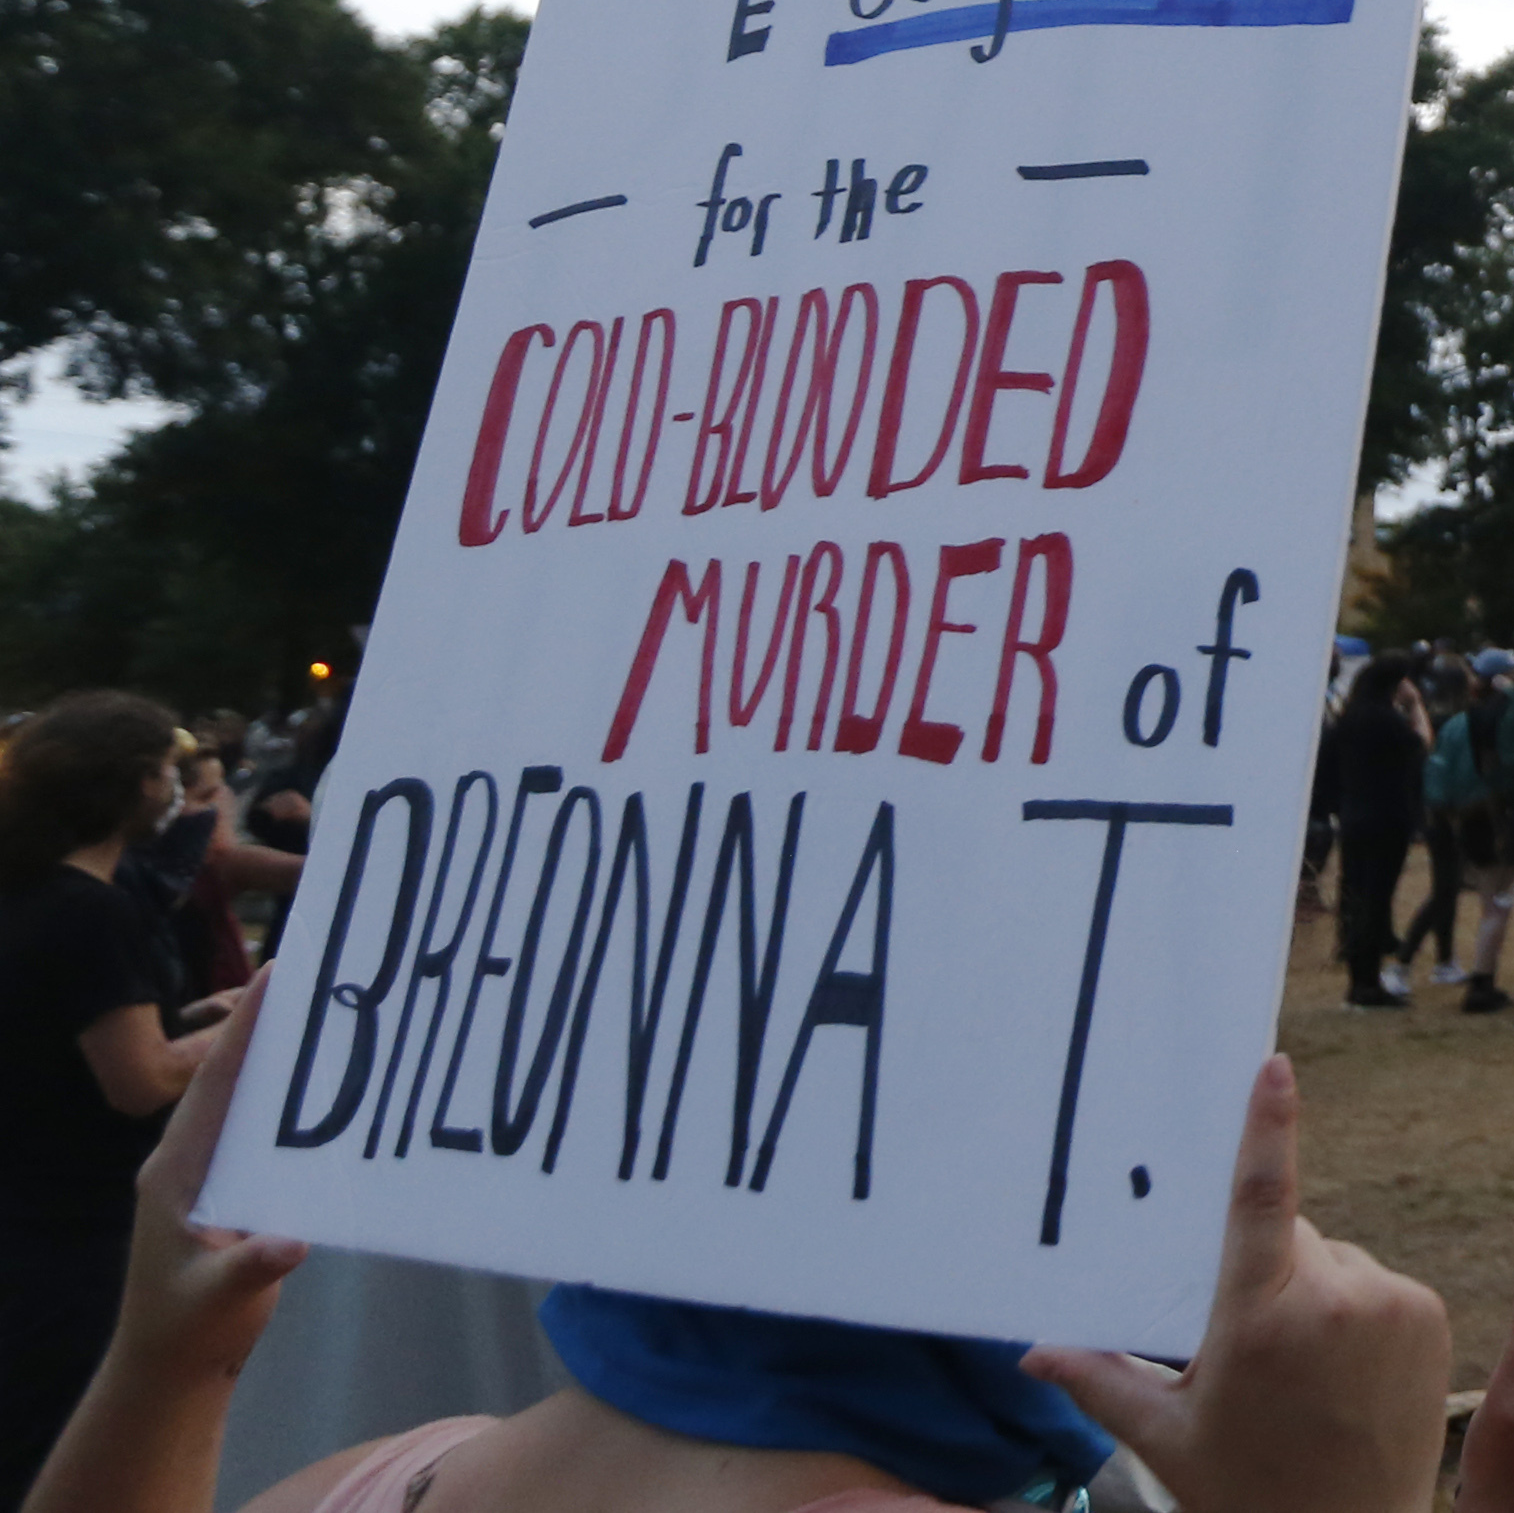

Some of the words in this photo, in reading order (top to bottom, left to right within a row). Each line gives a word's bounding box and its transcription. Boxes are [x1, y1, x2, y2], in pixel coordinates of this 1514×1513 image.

[694, 142, 781, 267] for
[812, 159, 930, 244] the
[458, 259, 1151, 546] COLD-BLOODED
[600, 531, 1074, 765] MURDER
[1123, 567, 1259, 748] of
[276, 764, 894, 1200] BREONNA
[1022, 799, 1234, 1247] T.
